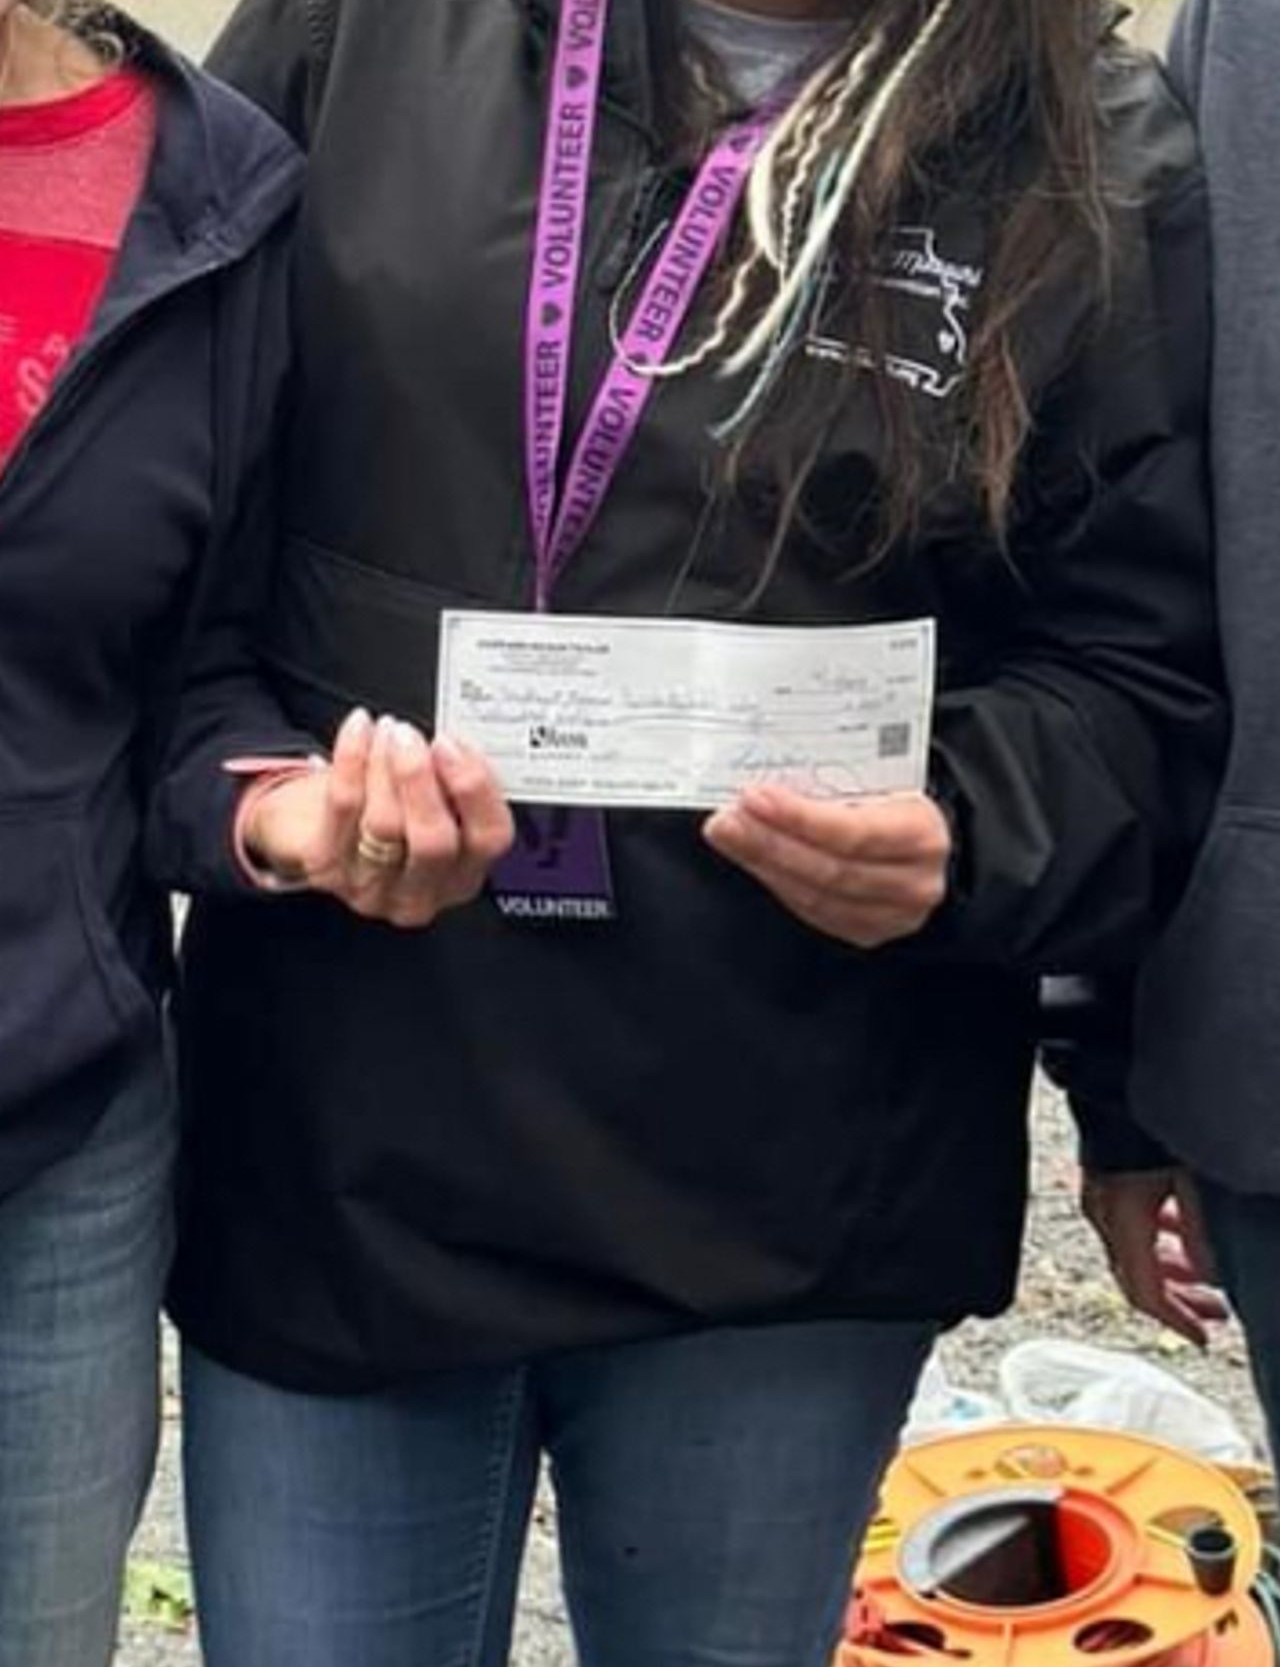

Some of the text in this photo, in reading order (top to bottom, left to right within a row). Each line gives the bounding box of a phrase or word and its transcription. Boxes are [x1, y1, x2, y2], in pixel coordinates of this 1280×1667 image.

[540, 101, 588, 288] VOLUNTEER
[637, 165, 739, 343] VOLUNTEER
[496, 895, 611, 920] VOLUNTEER
